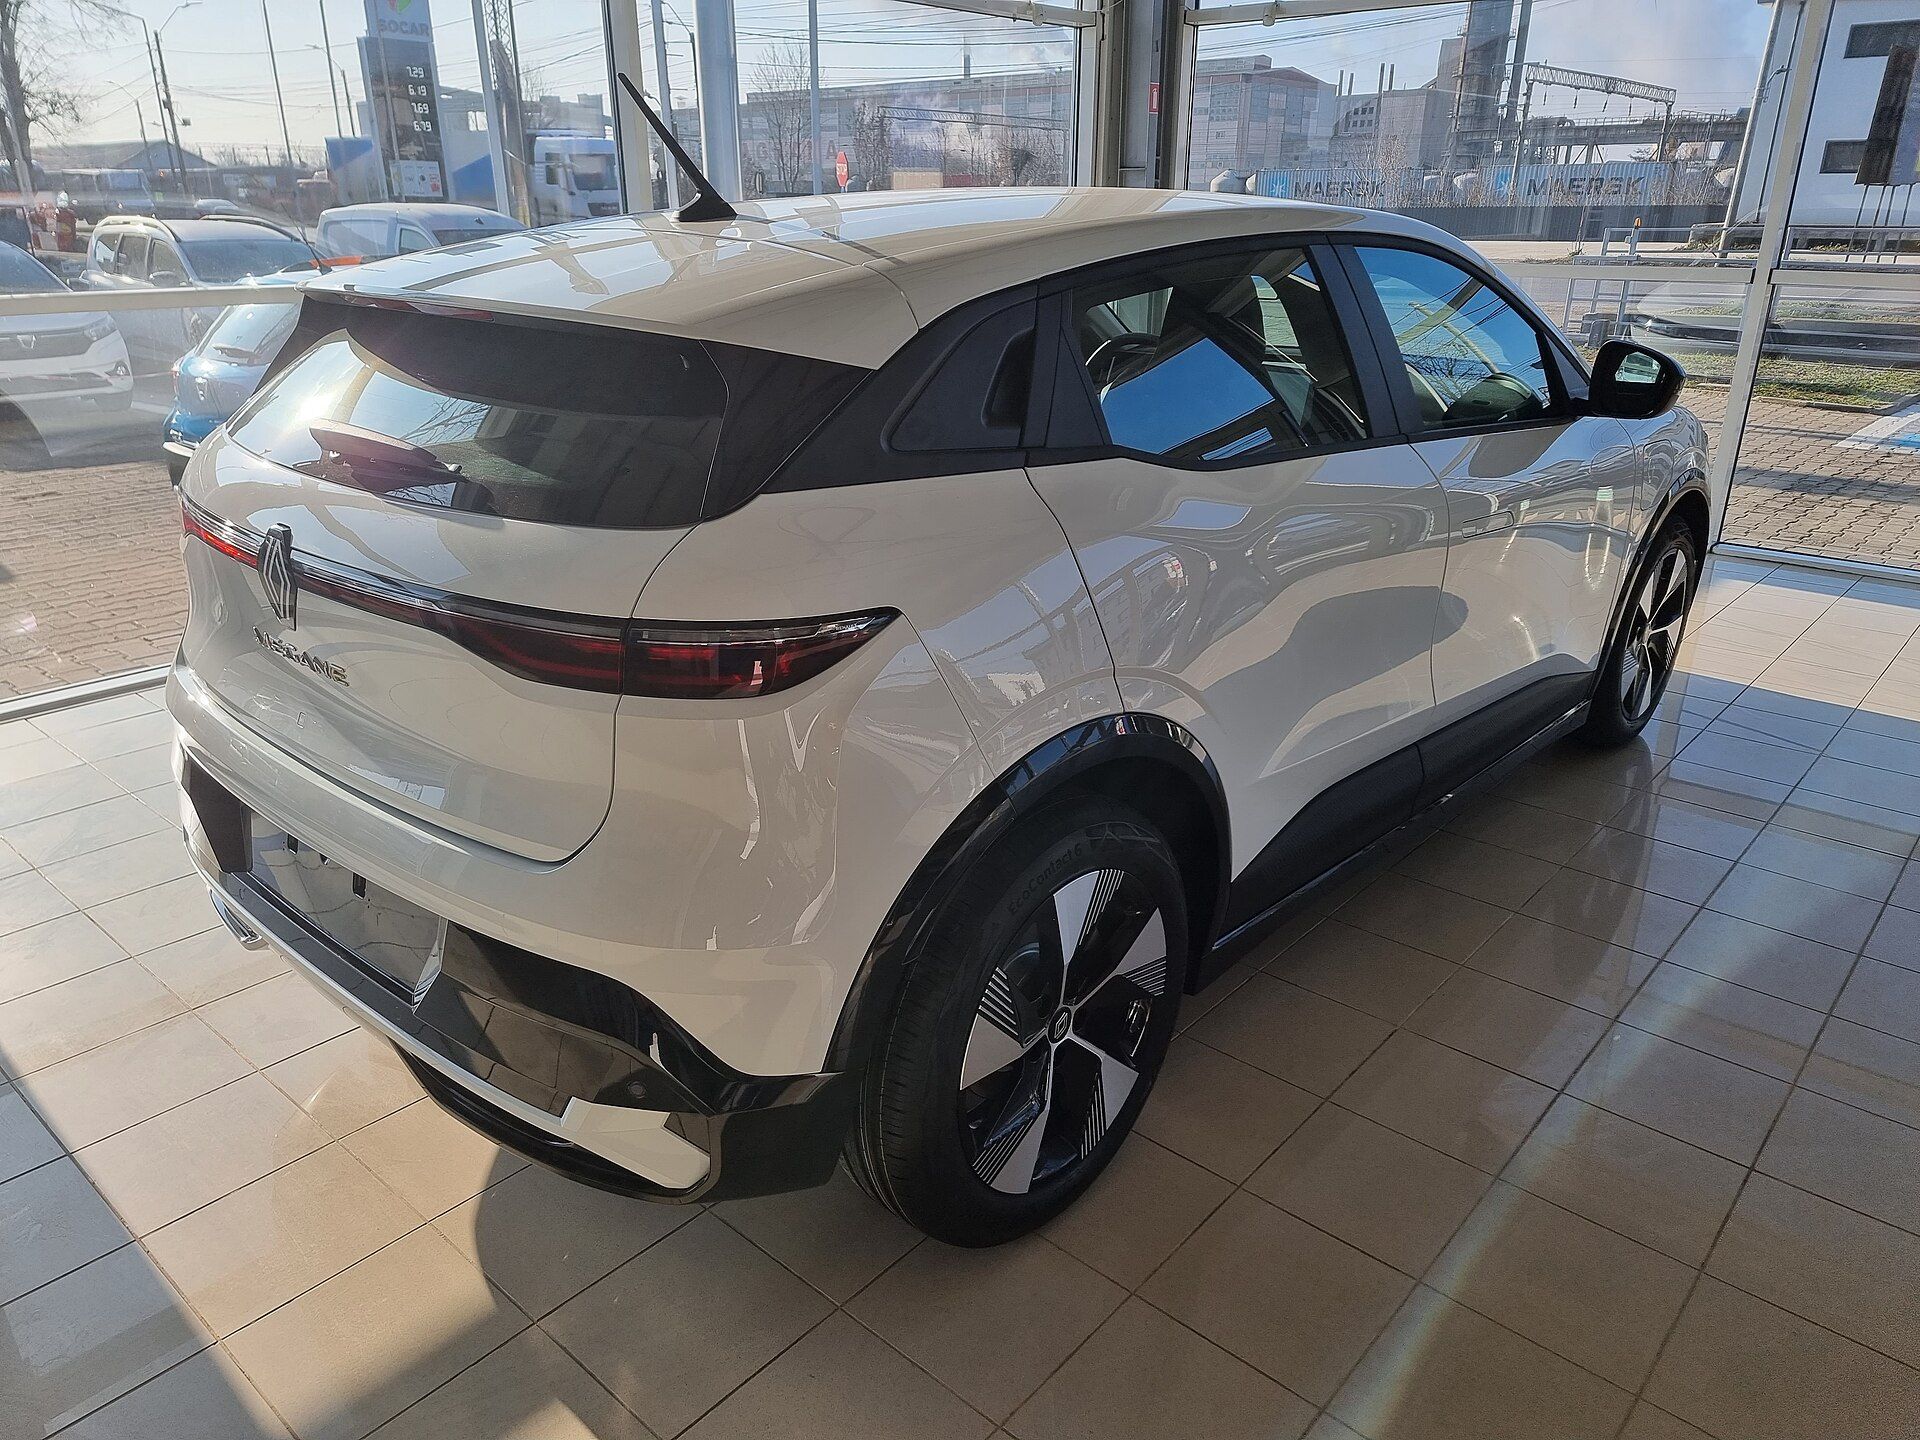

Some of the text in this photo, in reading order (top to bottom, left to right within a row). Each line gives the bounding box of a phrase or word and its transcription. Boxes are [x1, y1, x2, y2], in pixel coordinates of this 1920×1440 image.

[378, 19, 430, 37] SOCAR
[408, 84, 427, 96] 6.19
[1527, 176, 1645, 197] MAERSK
[1008, 843, 1082, 914] EcoContact 6
